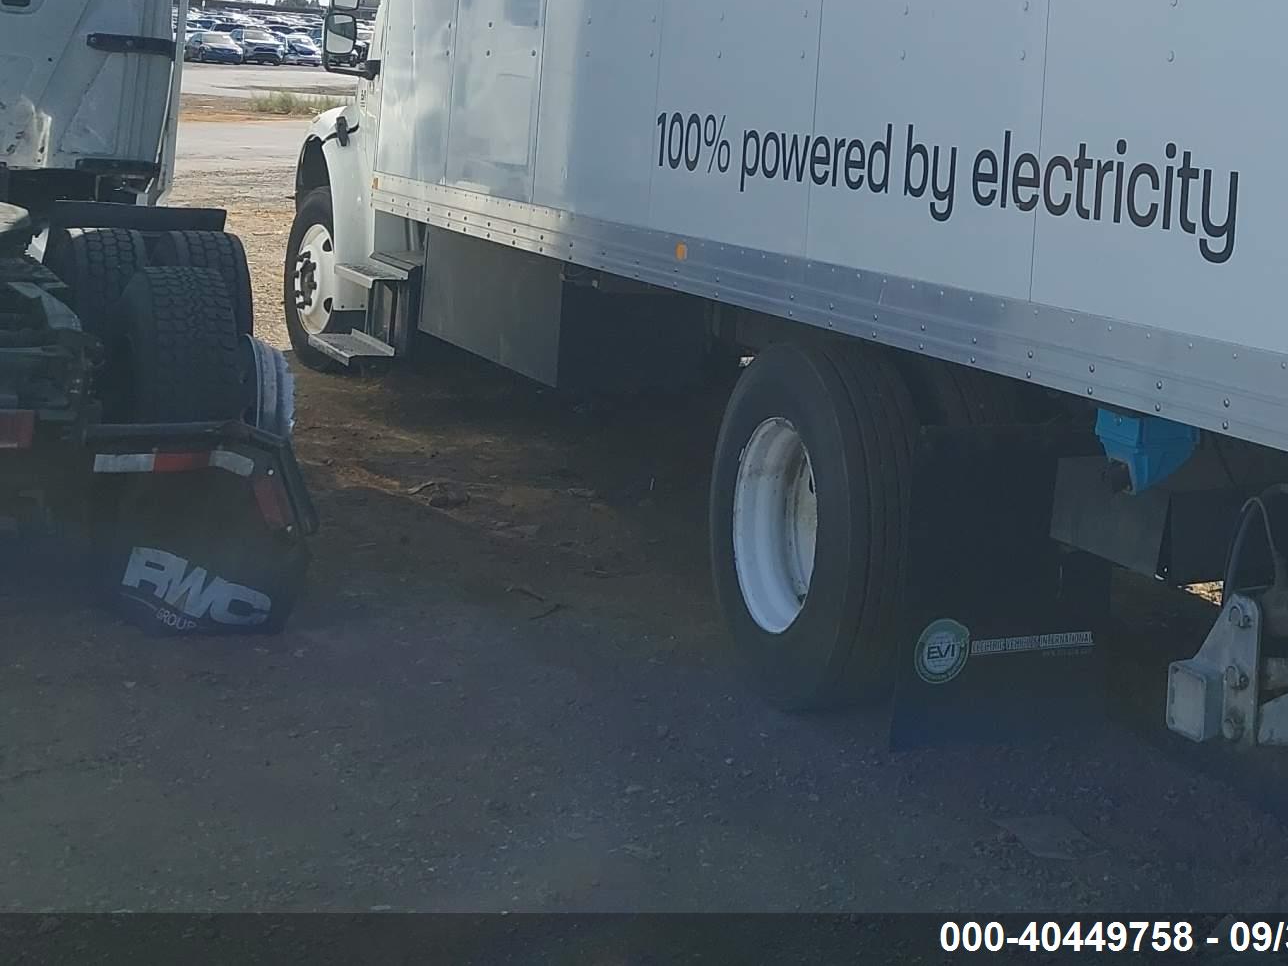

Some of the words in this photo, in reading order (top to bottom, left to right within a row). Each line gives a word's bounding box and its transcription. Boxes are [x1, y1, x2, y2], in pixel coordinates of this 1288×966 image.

[657, 112, 731, 174] 100%
[739, 123, 893, 194] powered
[905, 124, 957, 222] by
[972, 130, 1239, 264] electricity
[123, 546, 272, 626] RWC
[155, 607, 198, 631] GROUP
[927, 643, 956, 660] EVI
[1039, 631, 1094, 648] INTERNATIONAL
